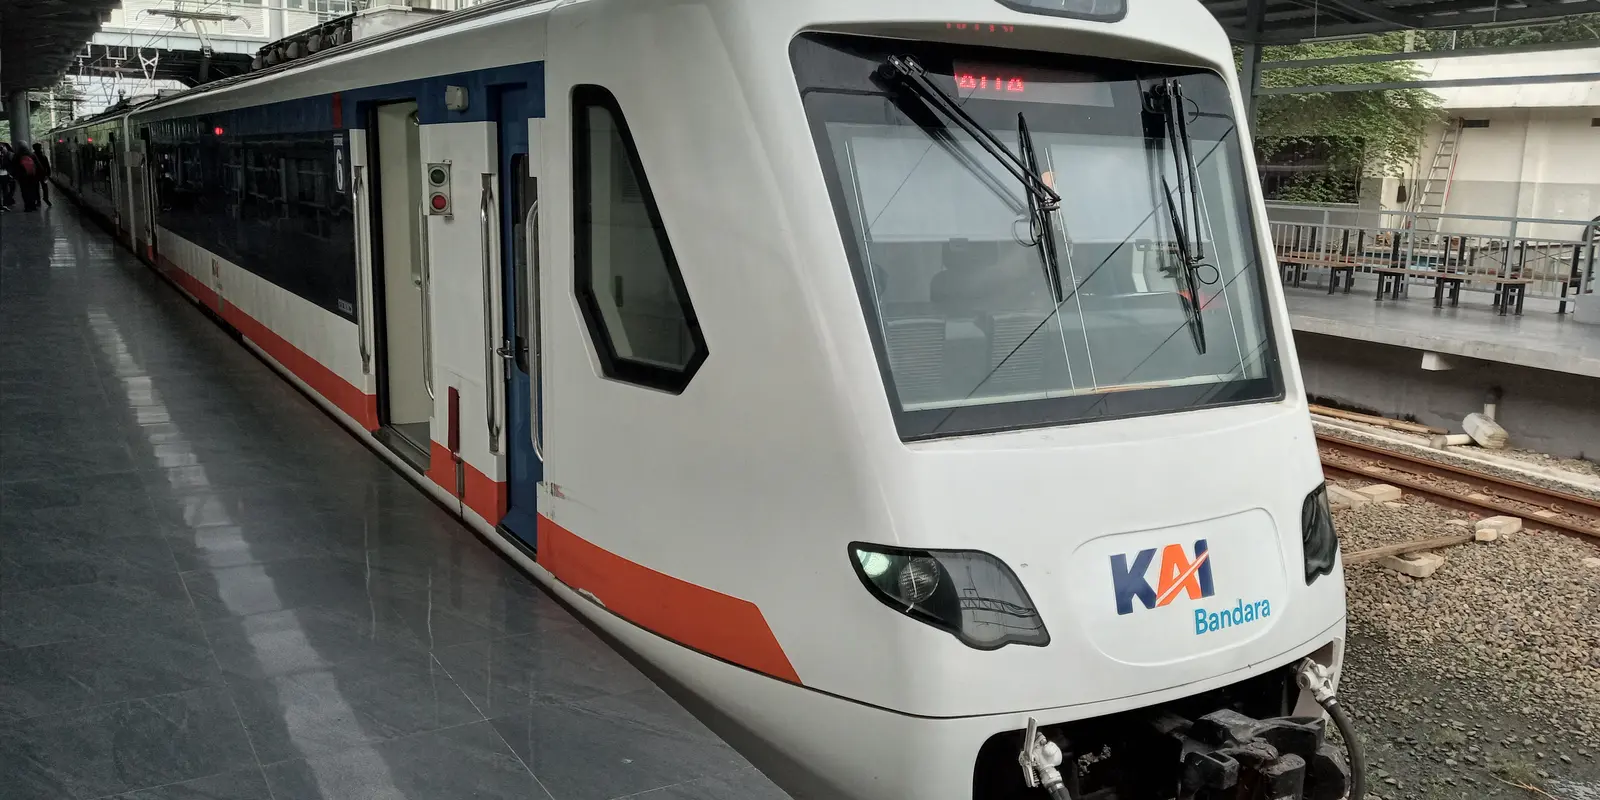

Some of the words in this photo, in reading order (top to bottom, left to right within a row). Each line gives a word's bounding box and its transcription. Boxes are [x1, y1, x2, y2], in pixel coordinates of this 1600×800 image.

[336, 149, 343, 190] 6
[1110, 539, 1215, 615] KAI
[1194, 598, 1271, 635] Bandara
